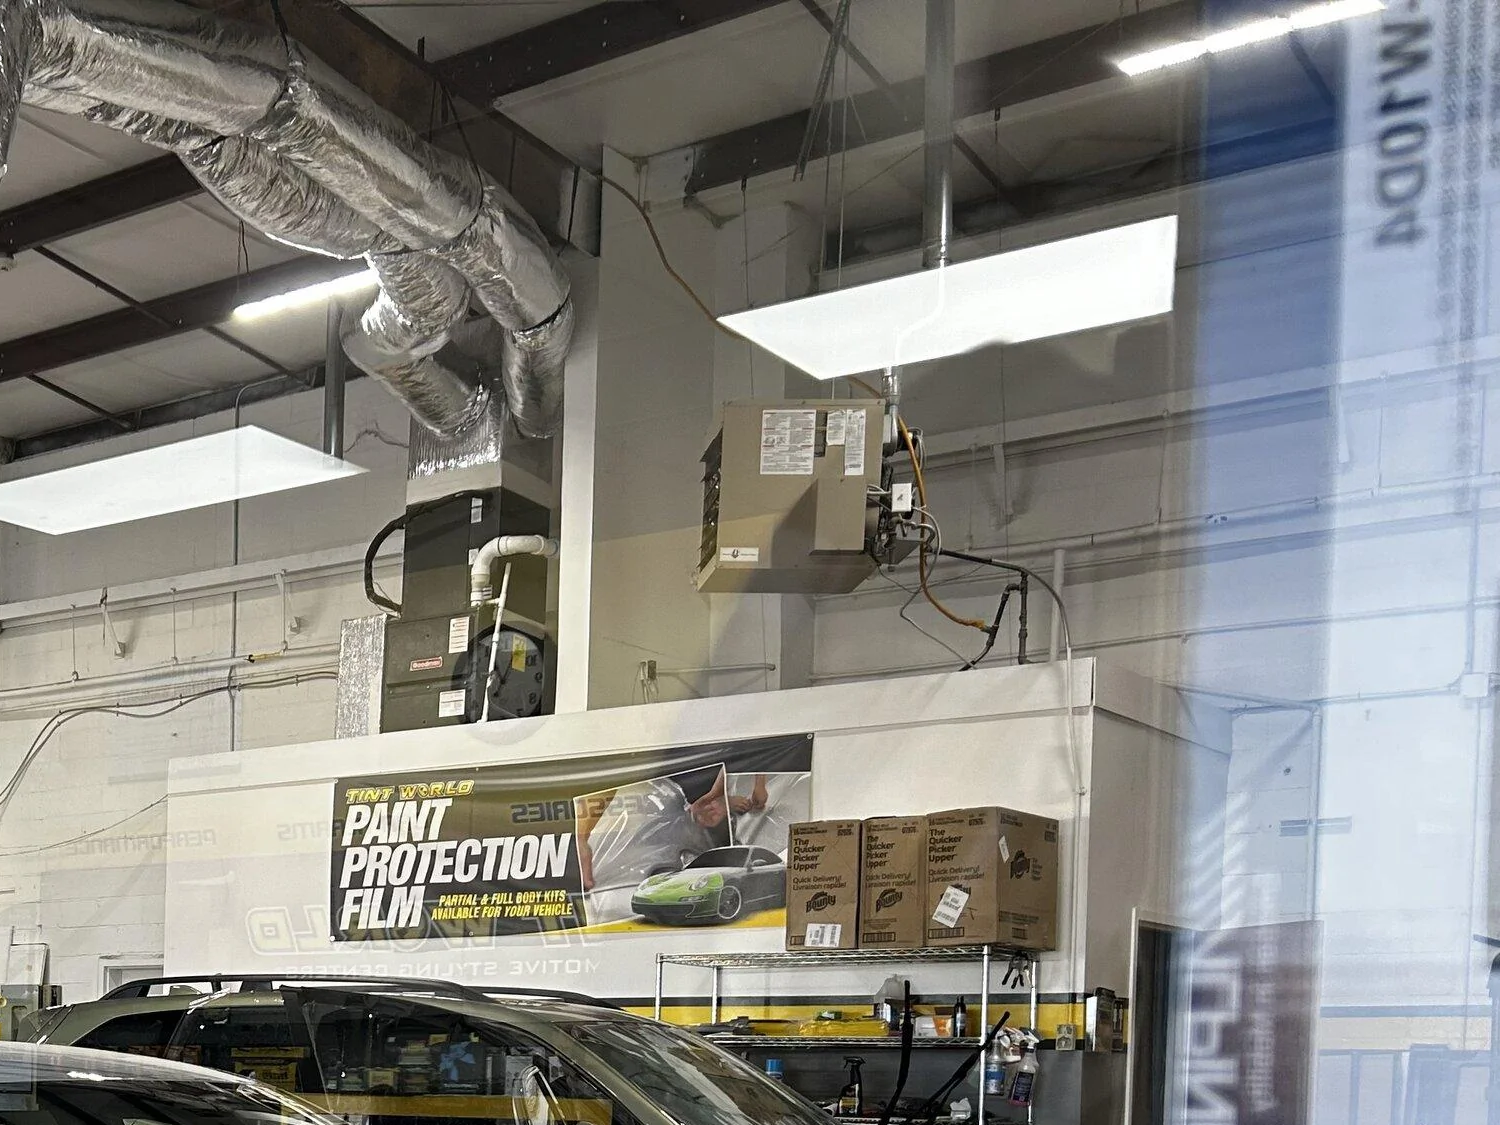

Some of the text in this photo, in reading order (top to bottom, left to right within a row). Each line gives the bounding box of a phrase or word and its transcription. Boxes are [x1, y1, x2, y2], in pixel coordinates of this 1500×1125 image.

[346, 780, 476, 804] TINT WORLD
[342, 798, 453, 847] PAINT
[794, 838, 809, 846] The
[930, 835, 963, 845] Quicker
[794, 845, 825, 854] Quicker
[866, 843, 896, 851] Quicker
[929, 845, 956, 853] Picker
[339, 833, 572, 889] PROTECTION
[794, 854, 820, 862] Picker
[929, 854, 957, 863] Upper
[793, 863, 818, 871] Upper
[866, 860, 889, 869] Upper
[439, 890, 566, 906] PARTIAL & FULL BODY KITS
[806, 891, 836, 913] Bounty
[339, 886, 426, 931] FILM
[431, 903, 573, 921] AVAILABLE FOR YOUR VEHICLE
